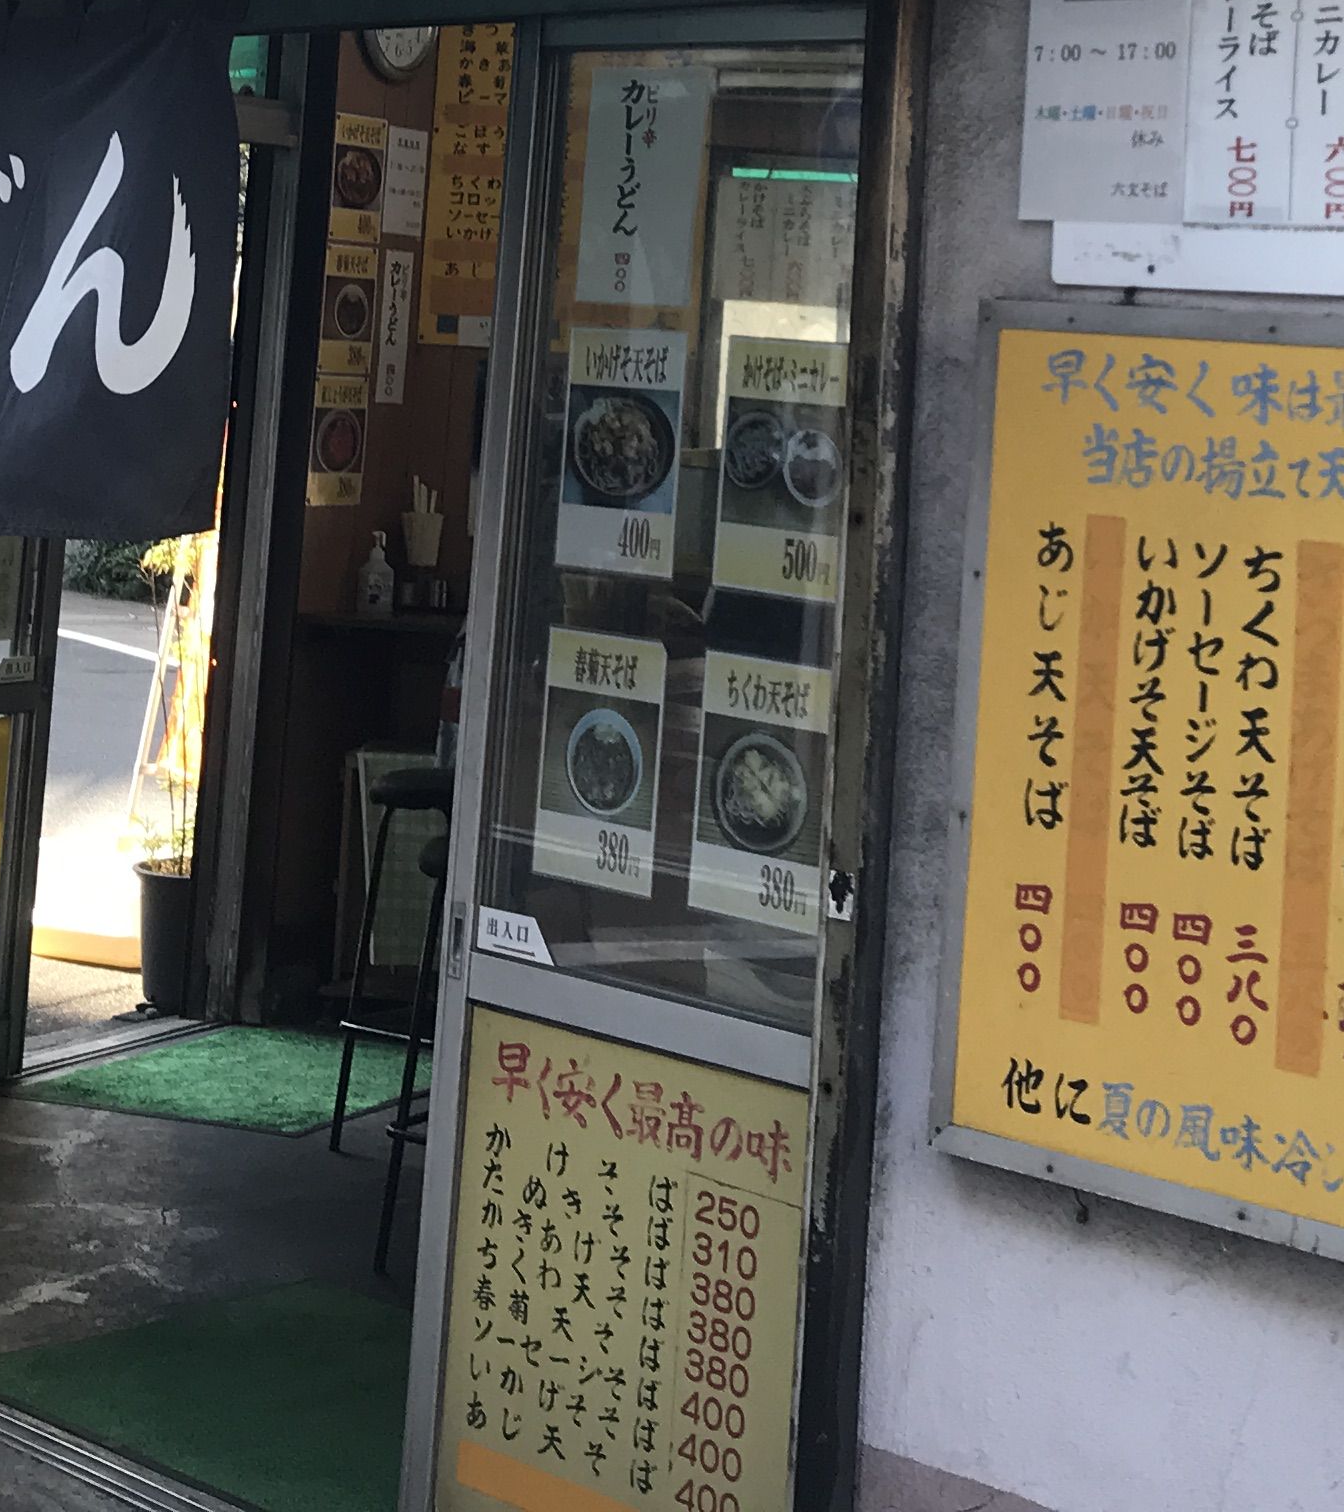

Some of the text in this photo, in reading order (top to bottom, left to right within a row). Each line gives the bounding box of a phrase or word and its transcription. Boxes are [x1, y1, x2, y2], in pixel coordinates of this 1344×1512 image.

[612, 79, 646, 237] カレーうどん
[1178, 542, 1228, 860] ソーセージそば
[1231, 546, 1284, 871] ちくわ天そば
[485, 915, 531, 945] 出入口
[694, 1189, 760, 1240] 250
[691, 1231, 757, 1280] 310
[690, 1272, 756, 1321] 380
[687, 1311, 752, 1360] 380
[684, 1349, 750, 1399] 380
[680, 1391, 746, 1439] 400
[677, 1433, 743, 1482] 400
